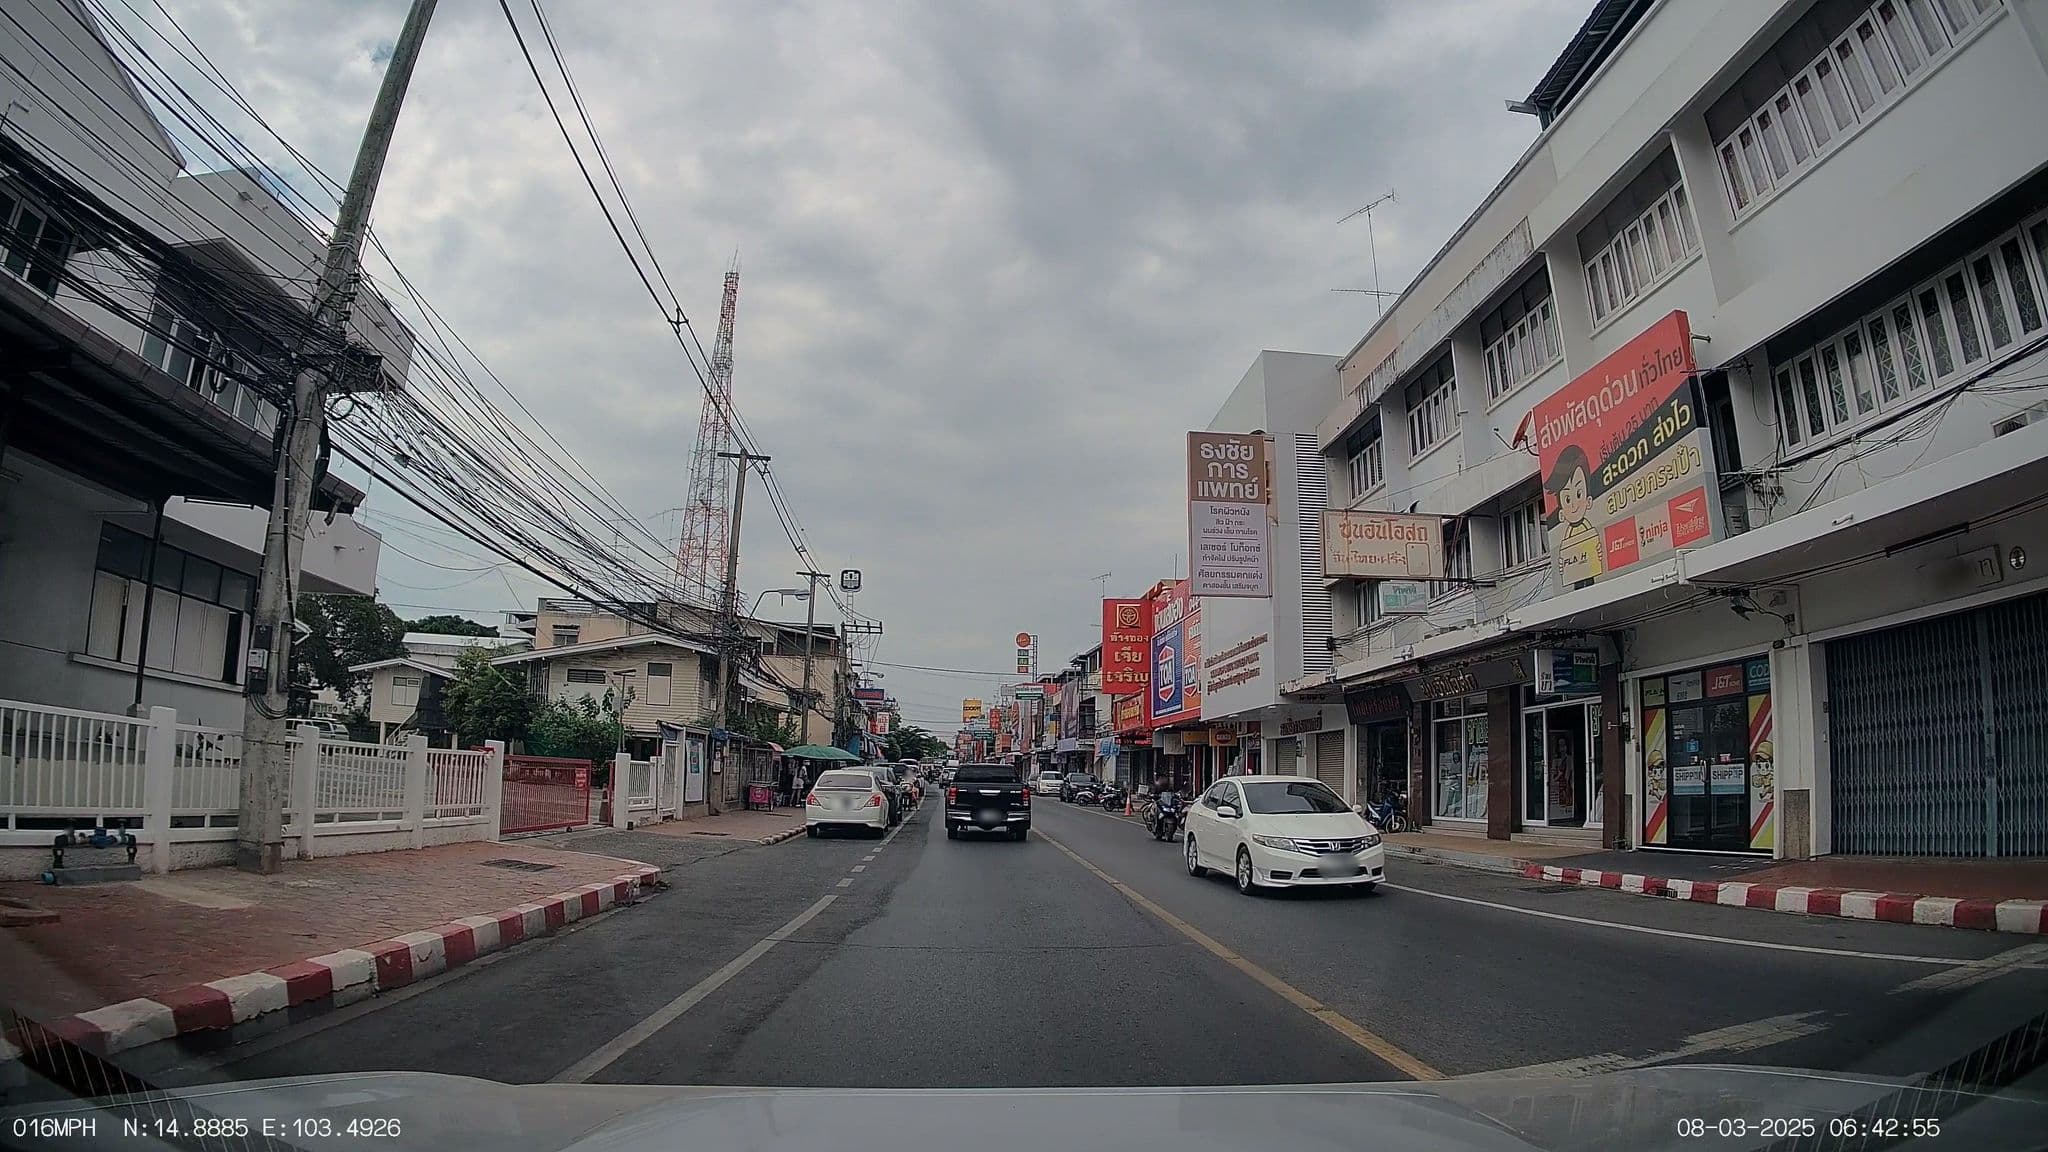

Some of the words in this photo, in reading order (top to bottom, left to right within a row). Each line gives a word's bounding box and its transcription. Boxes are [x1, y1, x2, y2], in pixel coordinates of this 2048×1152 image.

[1200, 438, 1254, 461] ธงชัย
[1602, 437, 1649, 486] สะดวก
[1653, 398, 1691, 447] ส่งไว
[1207, 461, 1249, 479] การ
[1606, 445, 1702, 515] สบายกระเป๋า
[1198, 476, 1259, 500] แพทย์
[1210, 506, 1250, 516] โรคผิวหนัง
[1645, 520, 1668, 538] ninja
[1160, 660, 1173, 687] TOA
